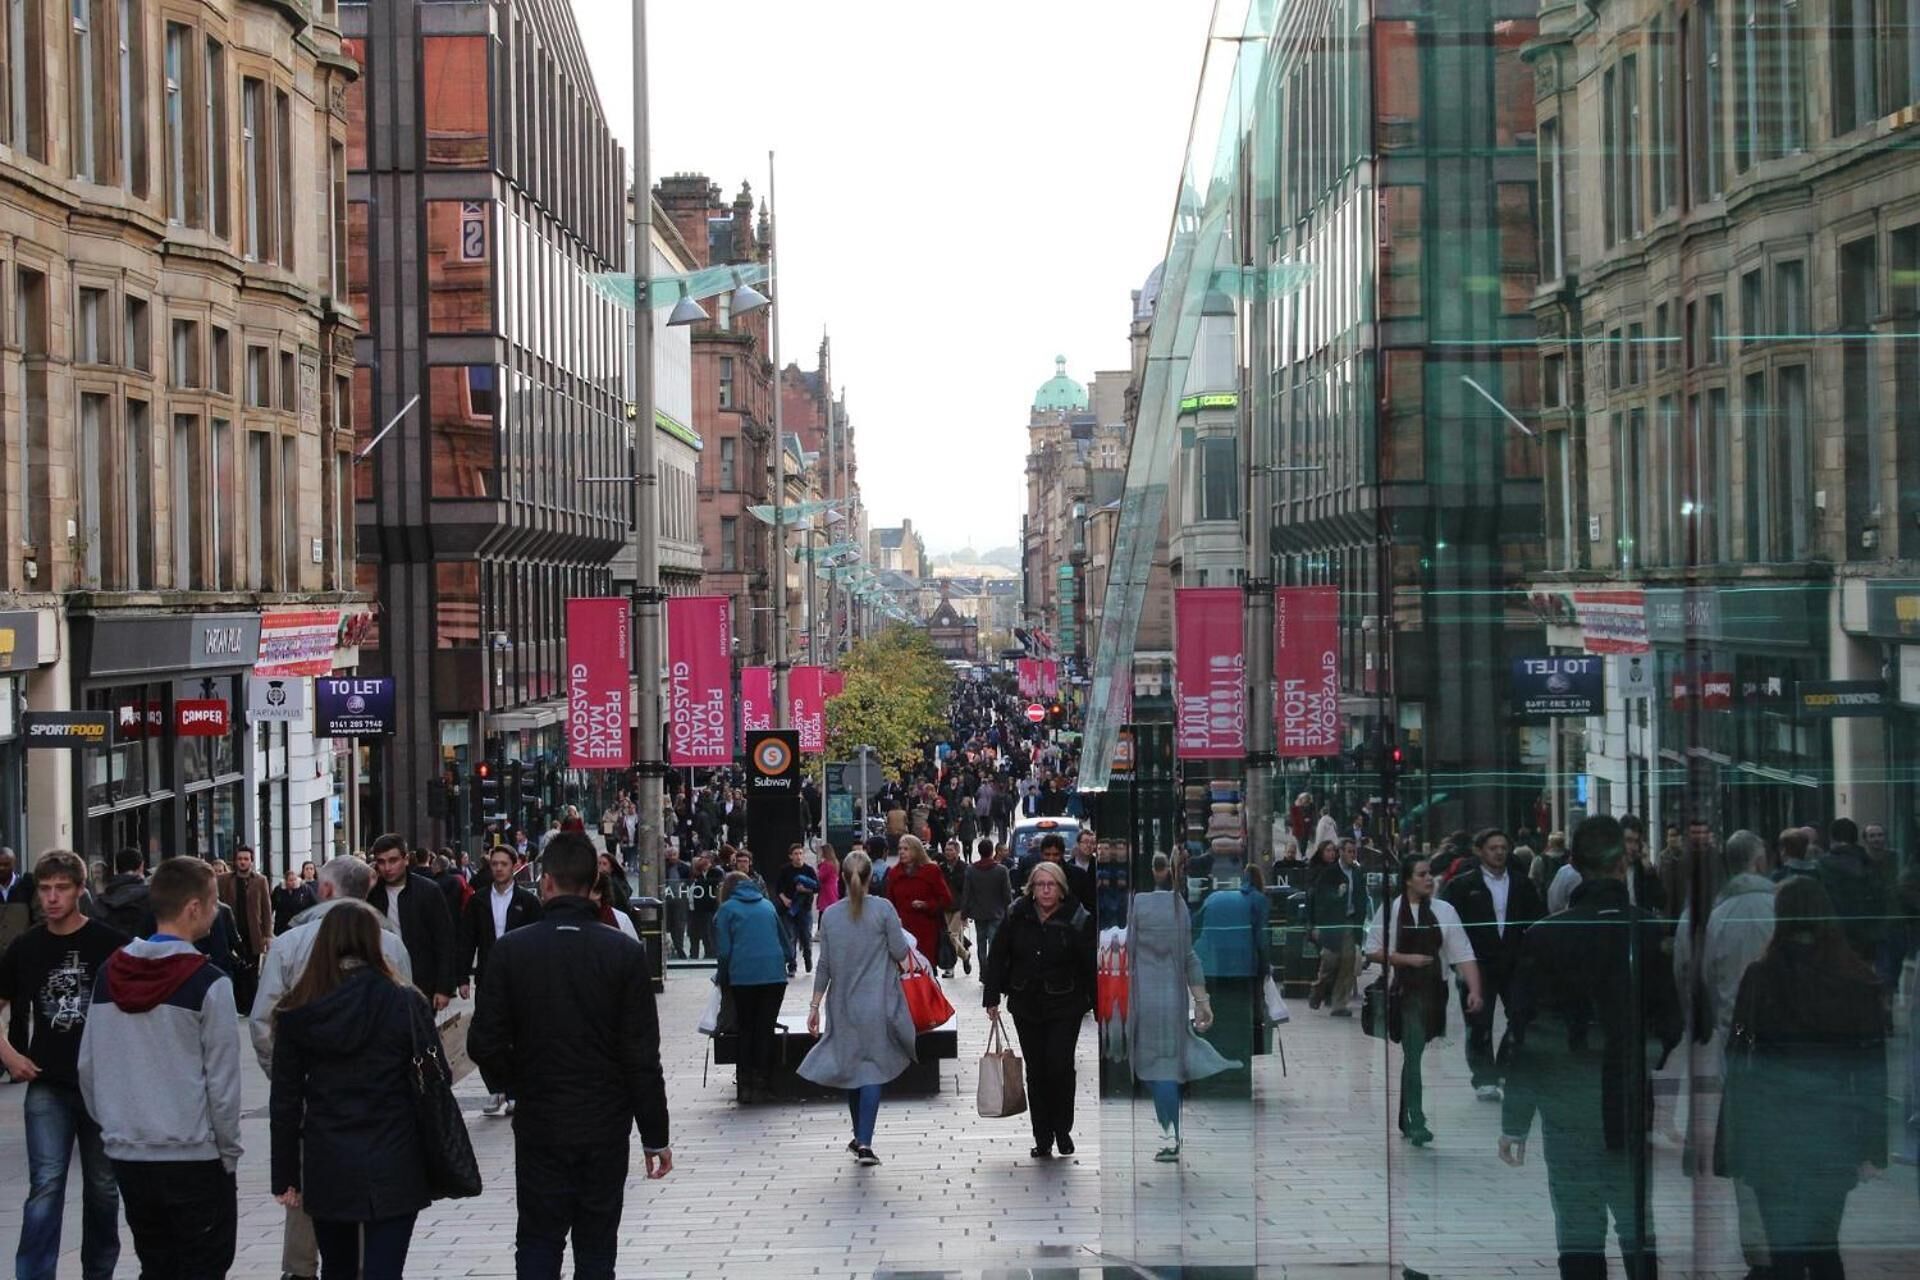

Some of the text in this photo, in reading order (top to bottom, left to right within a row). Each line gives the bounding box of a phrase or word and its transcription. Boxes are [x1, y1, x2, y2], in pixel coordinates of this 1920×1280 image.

[329, 680, 383, 695] TO LET
[572, 664, 588, 758] GLASGOW
[673, 662, 691, 756] GLASGOW
[30, 724, 105, 736] SPORTFOOD
[183, 710, 222, 725] CAMPER
[589, 705, 605, 758] MAKE
[605, 690, 622, 758] PEOPLE
[691, 703, 708, 756] MAKE
[707, 688, 725, 756] PEOPLE
[754, 777, 791, 789] Subway
